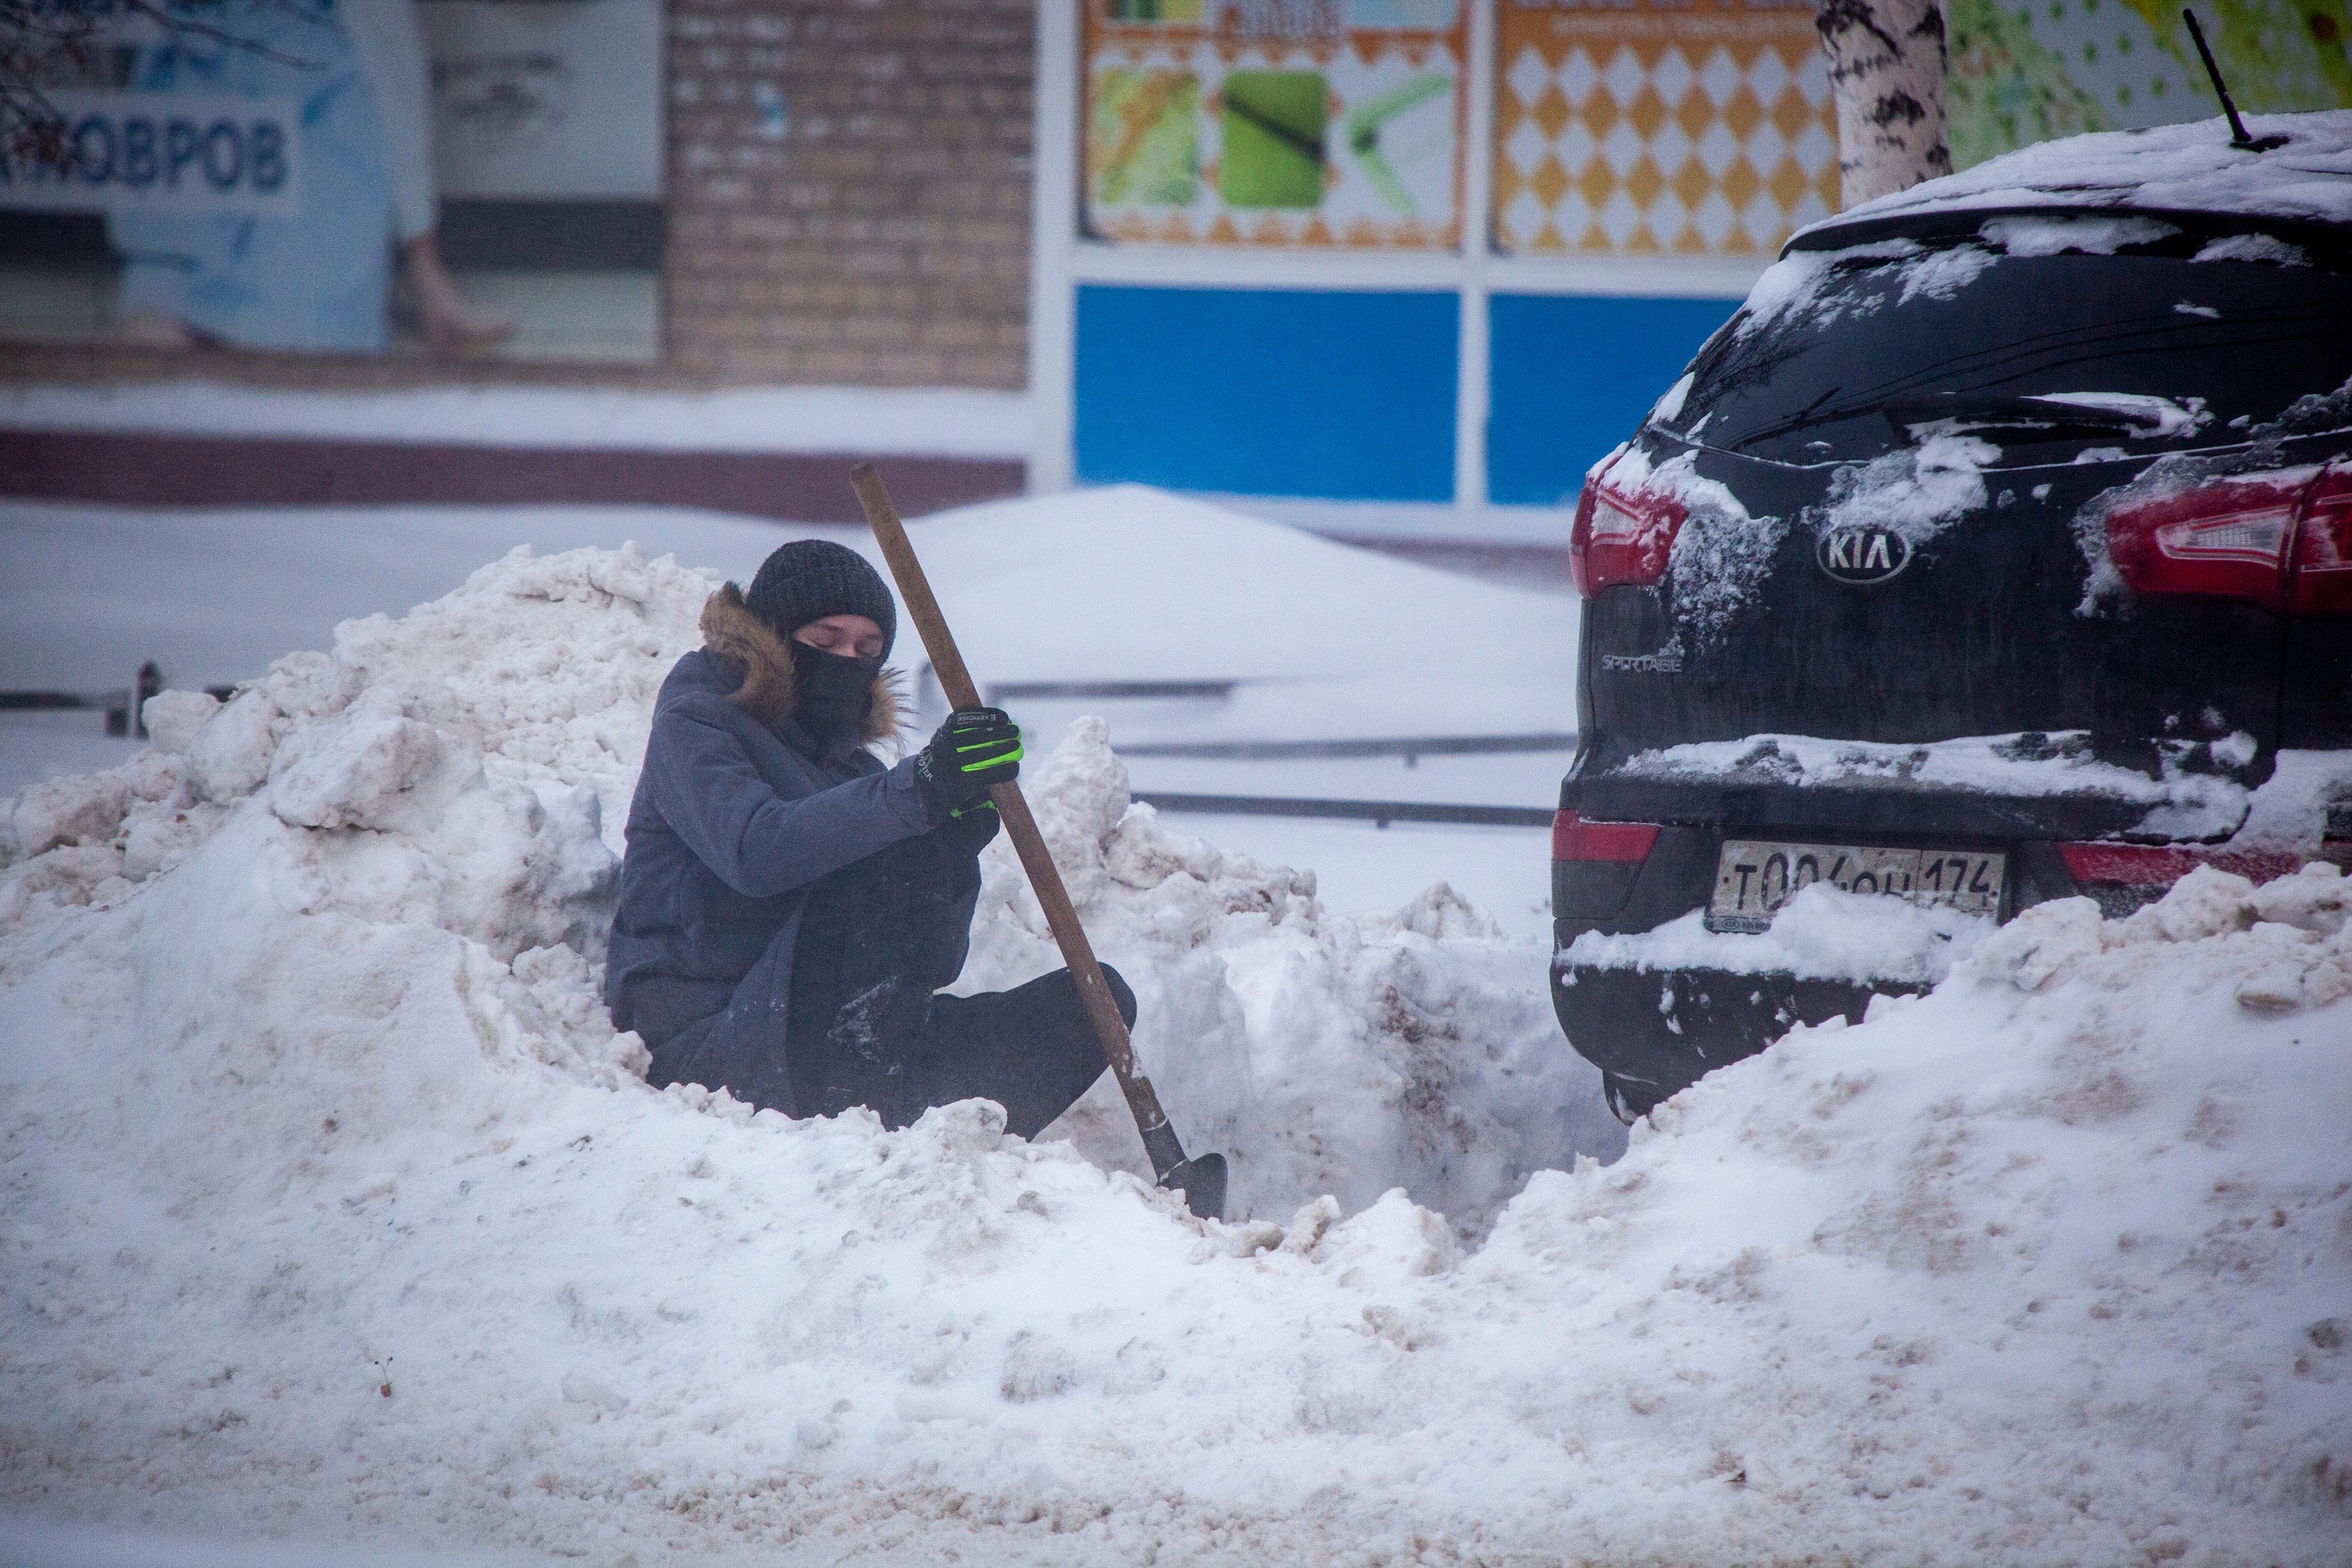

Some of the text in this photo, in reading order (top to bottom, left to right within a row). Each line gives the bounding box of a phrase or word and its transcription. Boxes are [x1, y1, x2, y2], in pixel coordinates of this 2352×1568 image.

[1828, 531, 1892, 569] KIA
[1602, 655, 1683, 672] SPORTAGE
[1924, 858, 1990, 908] 174
